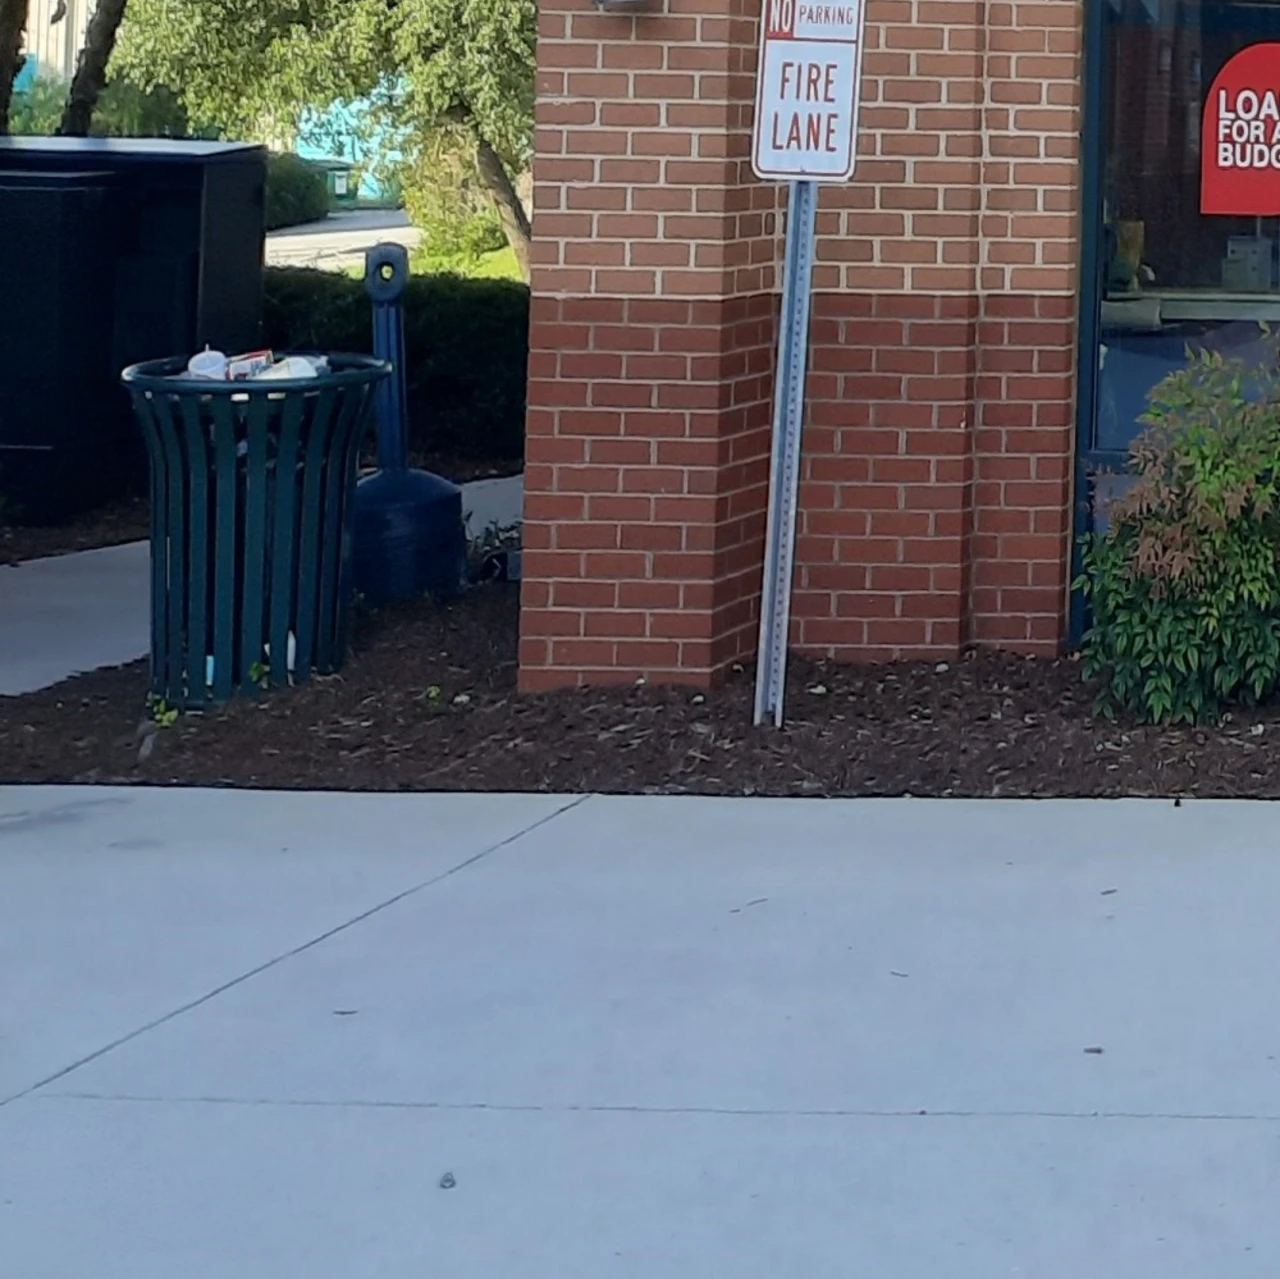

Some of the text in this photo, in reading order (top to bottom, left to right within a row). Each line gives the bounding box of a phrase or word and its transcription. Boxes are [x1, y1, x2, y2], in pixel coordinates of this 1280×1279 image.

[799, 4, 854, 26] PARKING
[779, 61, 838, 103] FIRE
[771, 111, 839, 153] LANE
[1218, 120, 1265, 143] FOR
